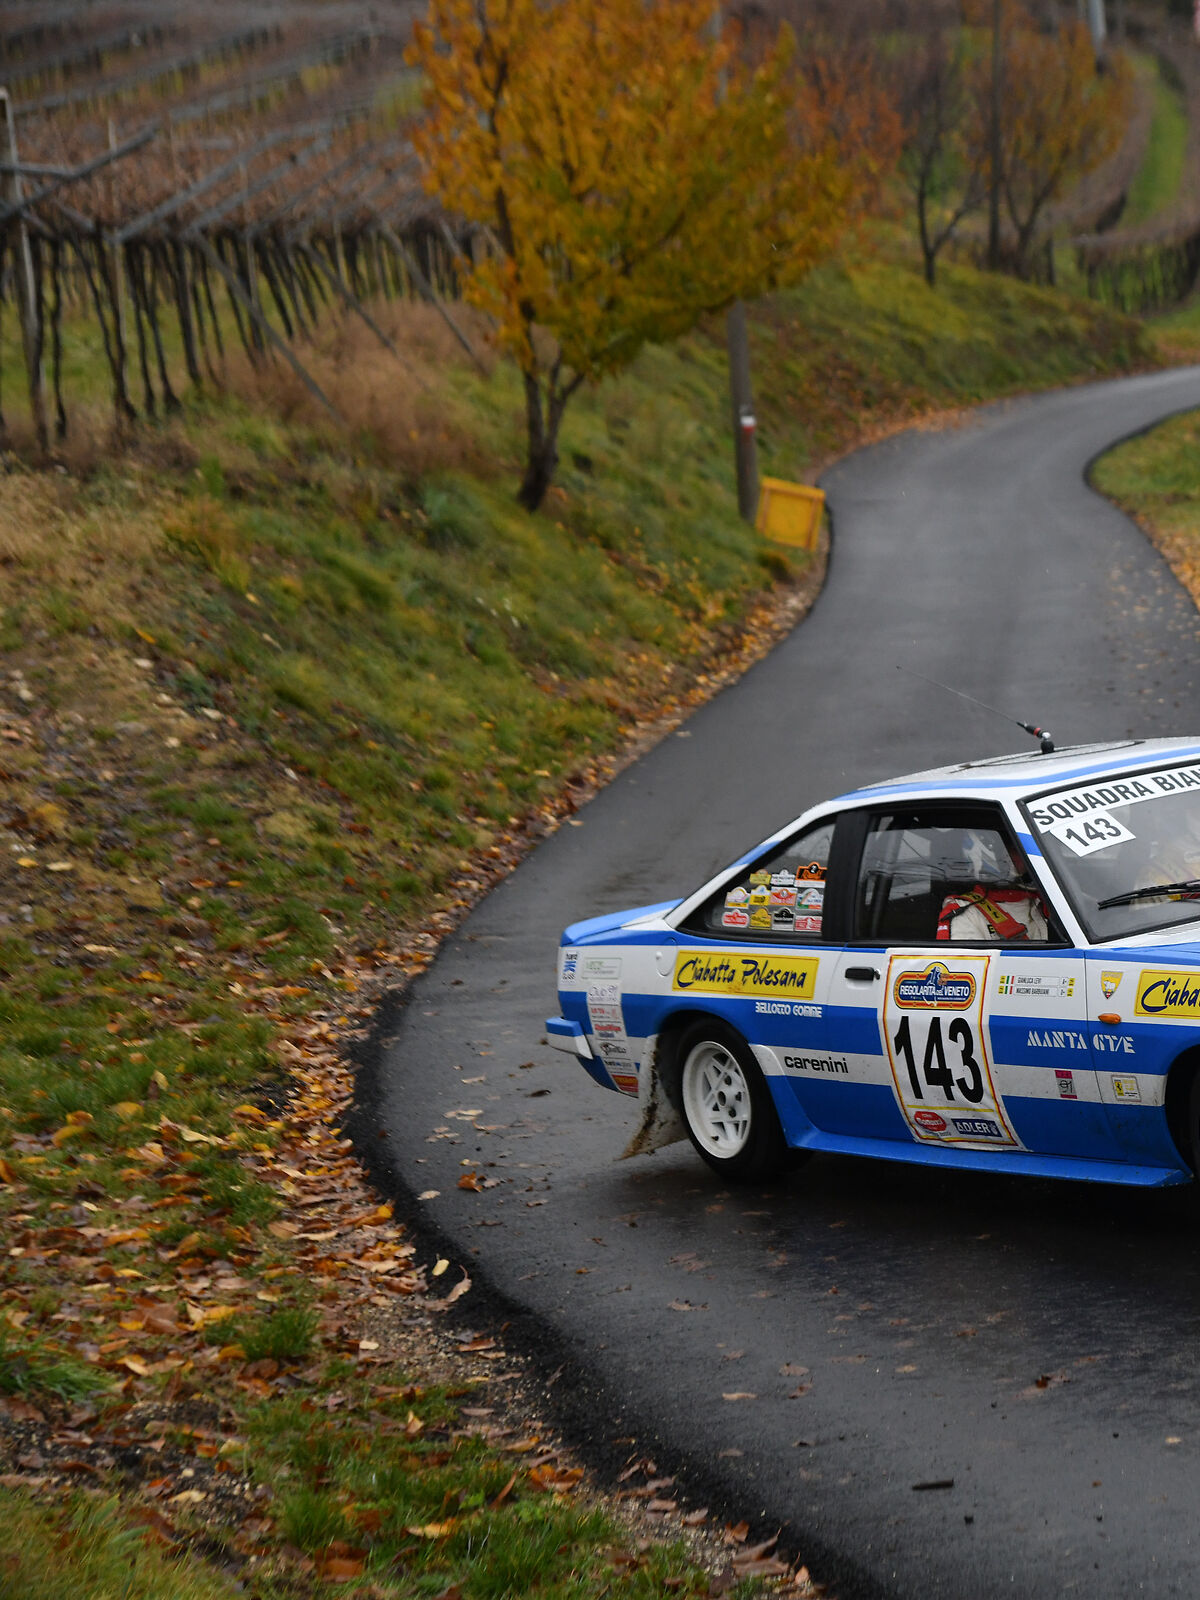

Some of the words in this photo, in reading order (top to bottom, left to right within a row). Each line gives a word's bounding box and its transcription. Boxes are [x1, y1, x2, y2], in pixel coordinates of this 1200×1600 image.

[1032, 780, 1153, 826] SQUADRA
[1065, 817, 1122, 847] 143
[677, 956, 736, 988] Ciabatta
[741, 959, 807, 989] Polesana
[944, 986, 970, 997] VENETO
[755, 1001, 791, 1016] BELLOTTO
[1027, 1030, 1088, 1050] MANTA
[1093, 1034, 1136, 1054] GT/E
[784, 1055, 849, 1074] carenini
[894, 1015, 984, 1104] 143
[956, 1121, 991, 1134] ADLER
